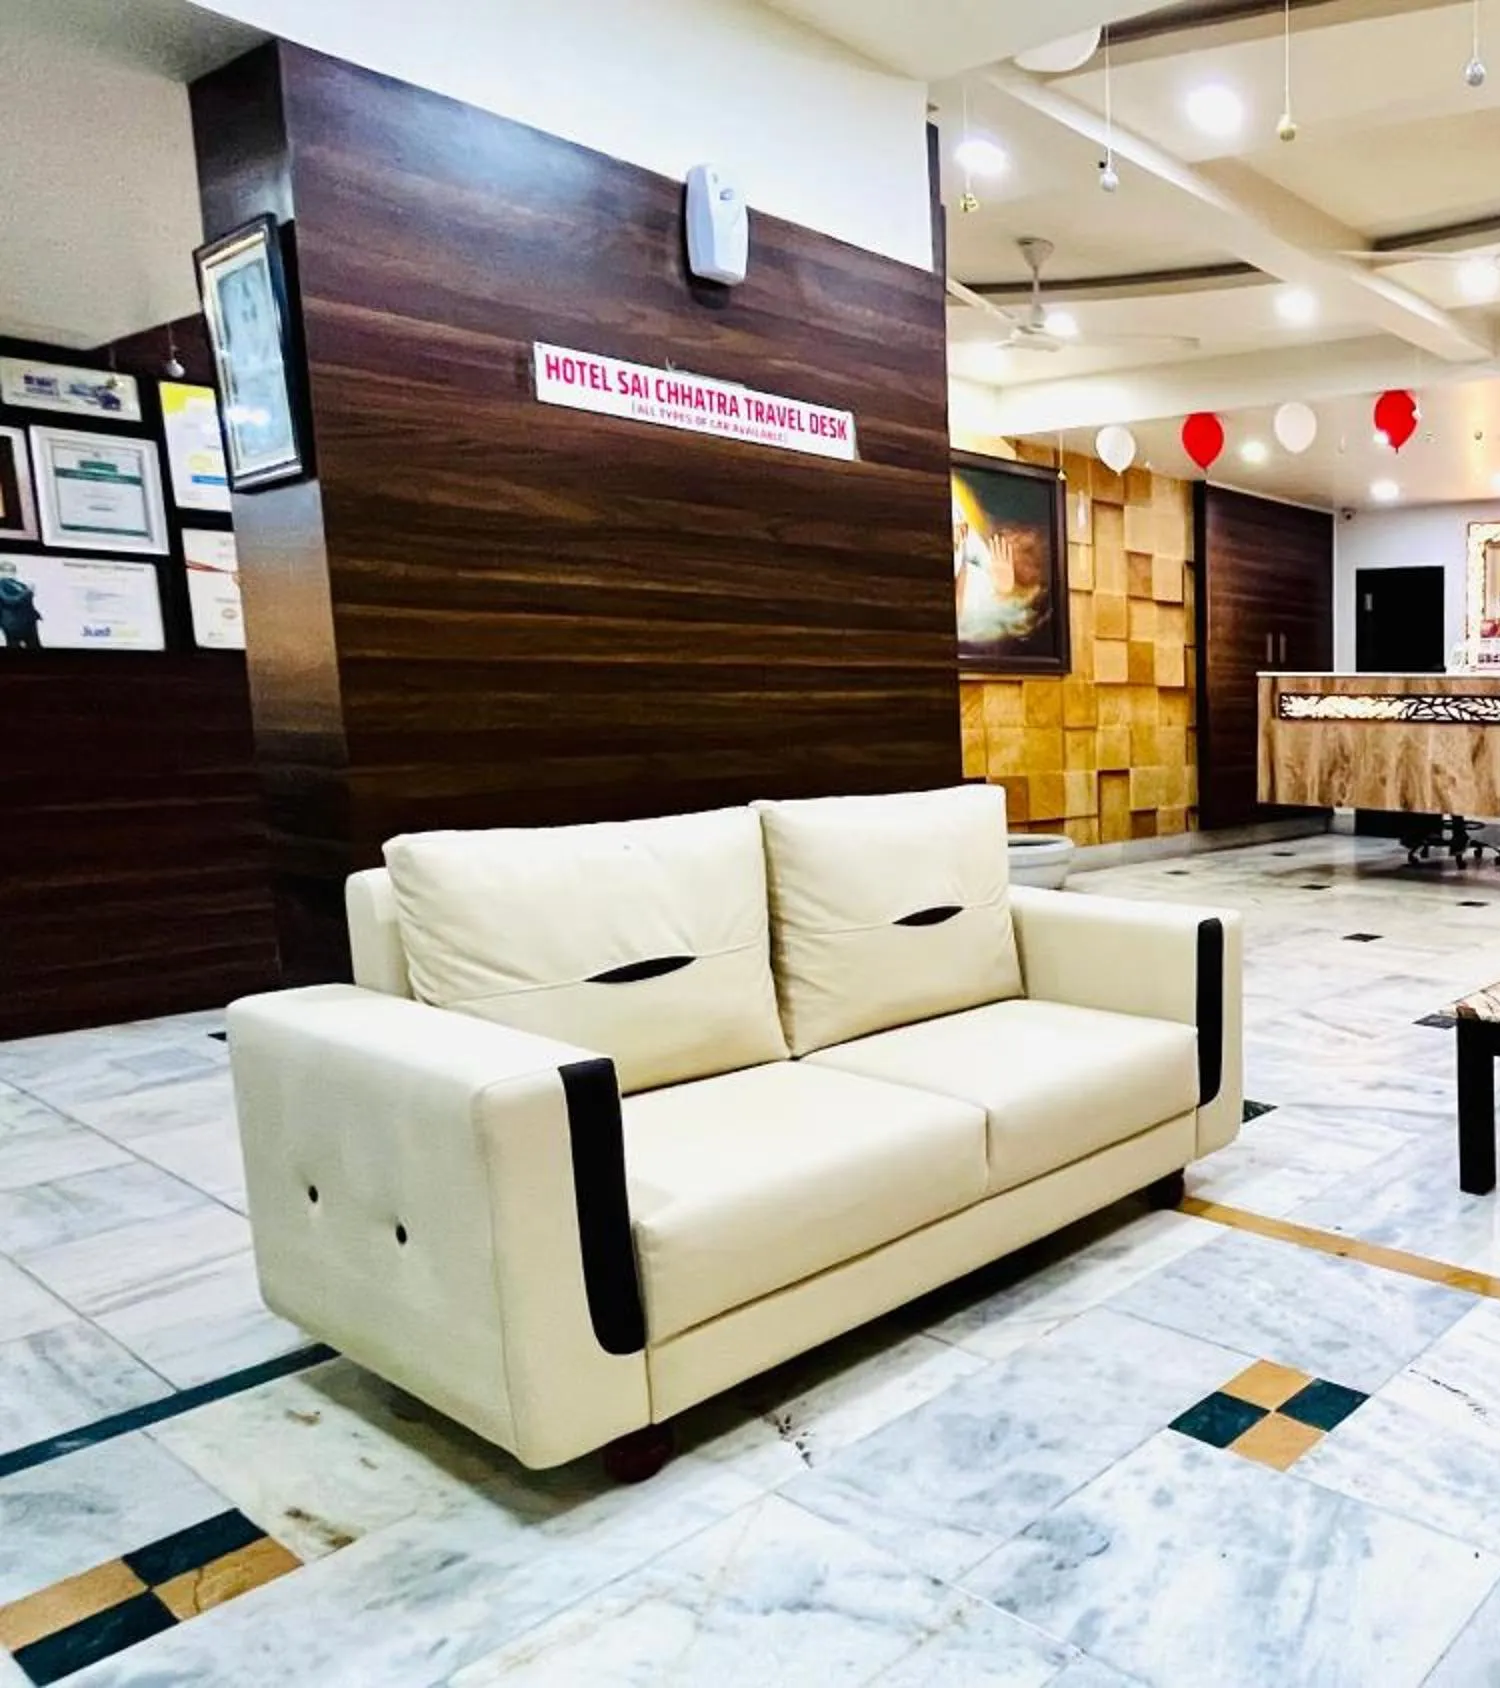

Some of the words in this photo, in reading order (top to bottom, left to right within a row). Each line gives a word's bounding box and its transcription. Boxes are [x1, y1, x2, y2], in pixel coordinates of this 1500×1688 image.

[545, 353, 613, 393] HOTEL
[617, 369, 649, 399] SAI
[655, 378, 740, 419] CHHATRA
[743, 397, 805, 433] TRAVEL
[809, 413, 848, 441] DESK
